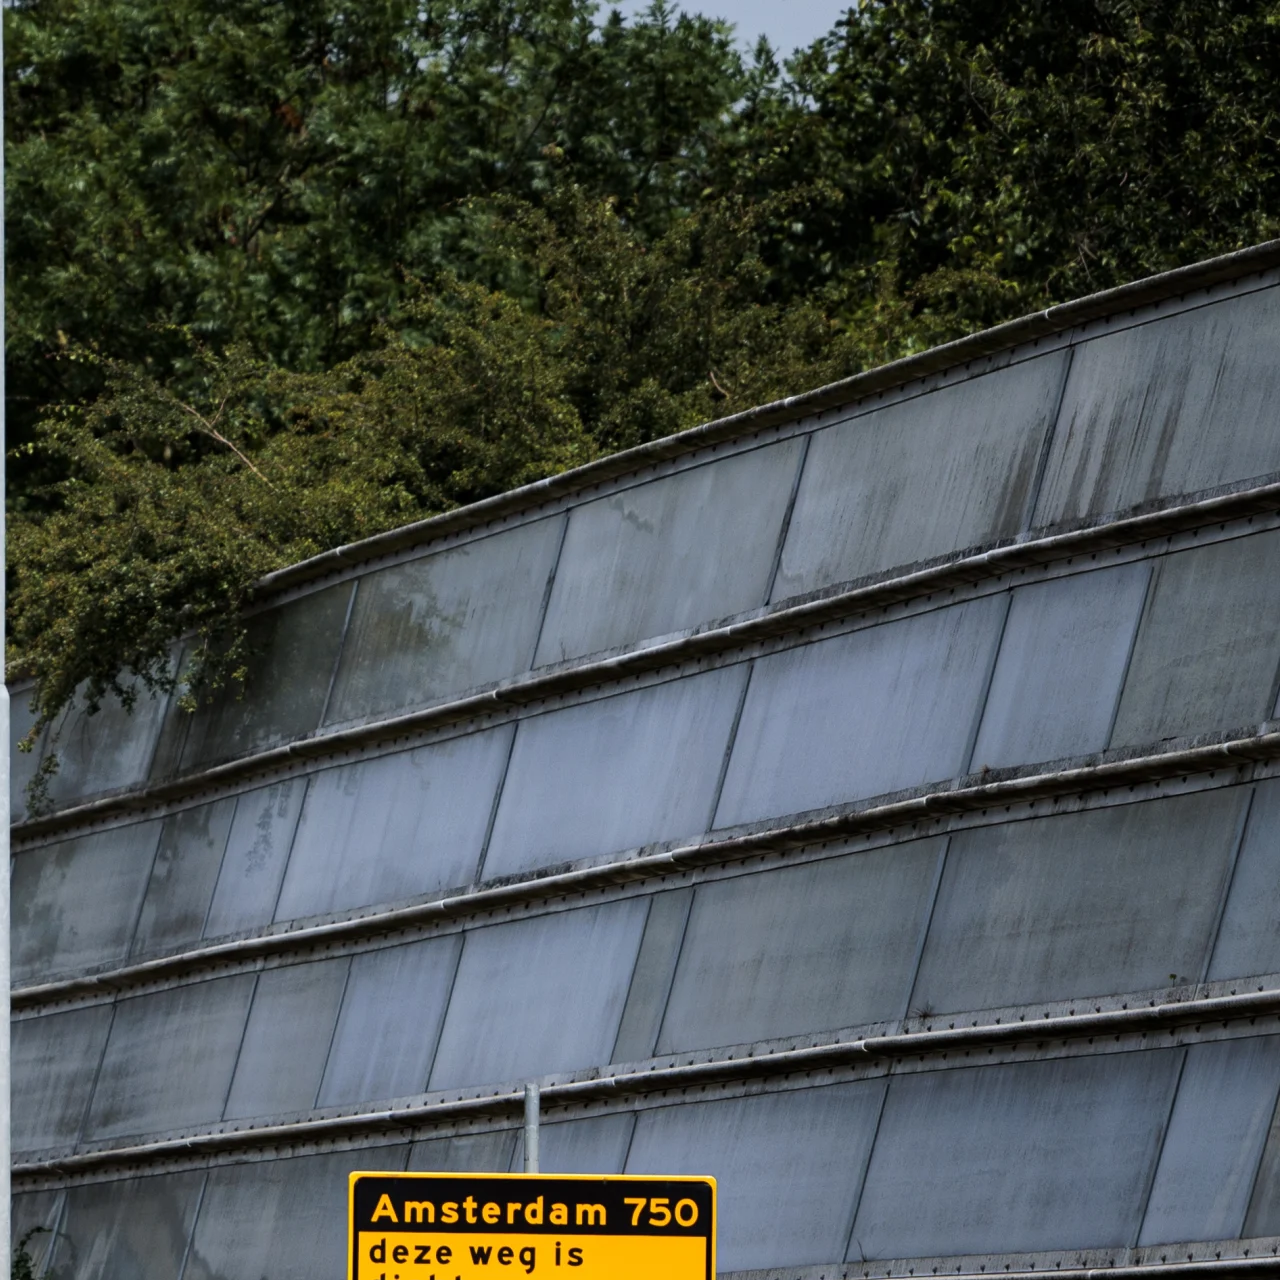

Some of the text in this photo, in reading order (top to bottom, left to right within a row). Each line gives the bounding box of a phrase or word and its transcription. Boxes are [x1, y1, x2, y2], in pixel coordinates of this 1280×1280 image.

[371, 1193, 699, 1227] Amsterdam 750
[369, 1238, 584, 1274] deze weg is
